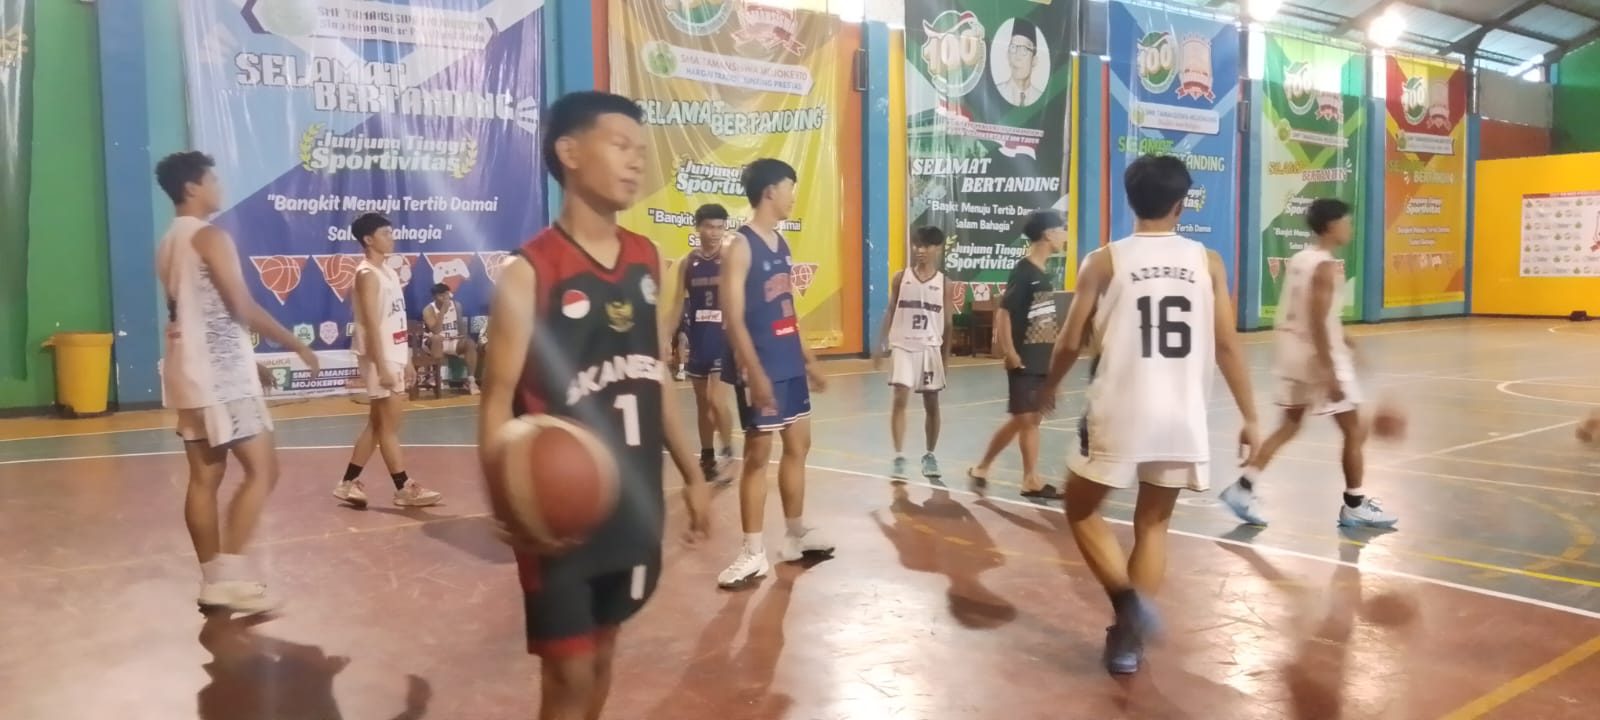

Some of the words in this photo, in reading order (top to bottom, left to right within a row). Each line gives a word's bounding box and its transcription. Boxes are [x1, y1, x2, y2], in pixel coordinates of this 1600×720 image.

[235, 52, 407, 89] SELAMAT
[313, 81, 518, 120] BERTANDING
[310, 148, 461, 174] Sportivitas
[676, 172, 747, 196] Sportiv
[960, 176, 1060, 193] BERTANDING
[266, 194, 340, 214] "Bangkit
[342, 194, 400, 214] Menuju
[402, 196, 448, 212] Tertib
[449, 196, 498, 212] Damai
[961, 202, 991, 216] Menuju
[992, 203, 1016, 216] Tertib
[649, 208, 694, 226] "Bangkit
[327, 225, 357, 241] Sal
[391, 224, 442, 243] ahagia
[994, 243, 1026, 258] Tinggi
[946, 253, 1018, 272] Sportivita
[911, 314, 929, 330] 27
[1136, 295, 1192, 359] 16
[923, 371, 935, 385] 27
[613, 393, 641, 447] 1
